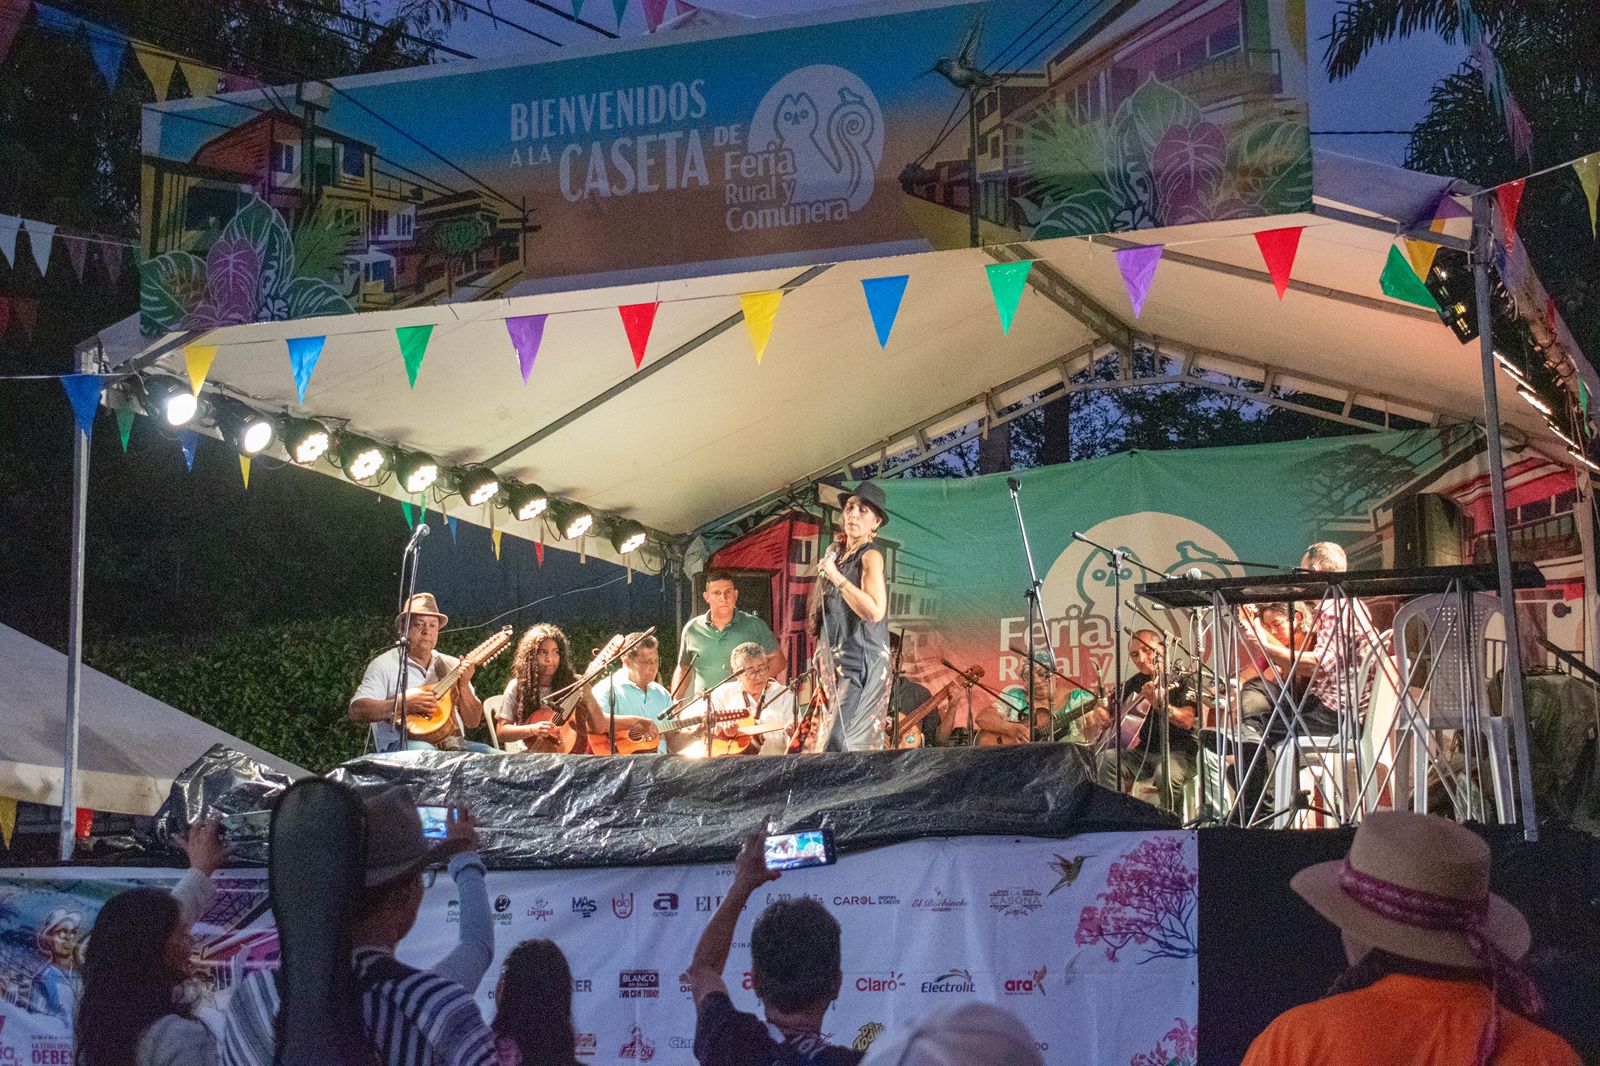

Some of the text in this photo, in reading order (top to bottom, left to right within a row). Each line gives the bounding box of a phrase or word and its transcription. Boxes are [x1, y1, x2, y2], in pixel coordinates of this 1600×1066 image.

[510, 79, 706, 142] BIENVENIDOS
[713, 125, 744, 147] DE
[509, 143, 552, 168] A LA
[559, 128, 710, 201] CASETA
[724, 141, 797, 180] Feria
[725, 175, 797, 207] Rural y
[725, 198, 850, 232] Comunera
[1000, 606, 1112, 652] Feria
[1000, 648, 1112, 688] Ral y
[833, 896, 876, 906] CAROL
[990, 896, 1041, 905] CASONA
[622, 974, 657, 983] BLANCO
[855, 977, 898, 992] Claro
[921, 981, 976, 993] Electrolit
[1004, 979, 1033, 992] ara
